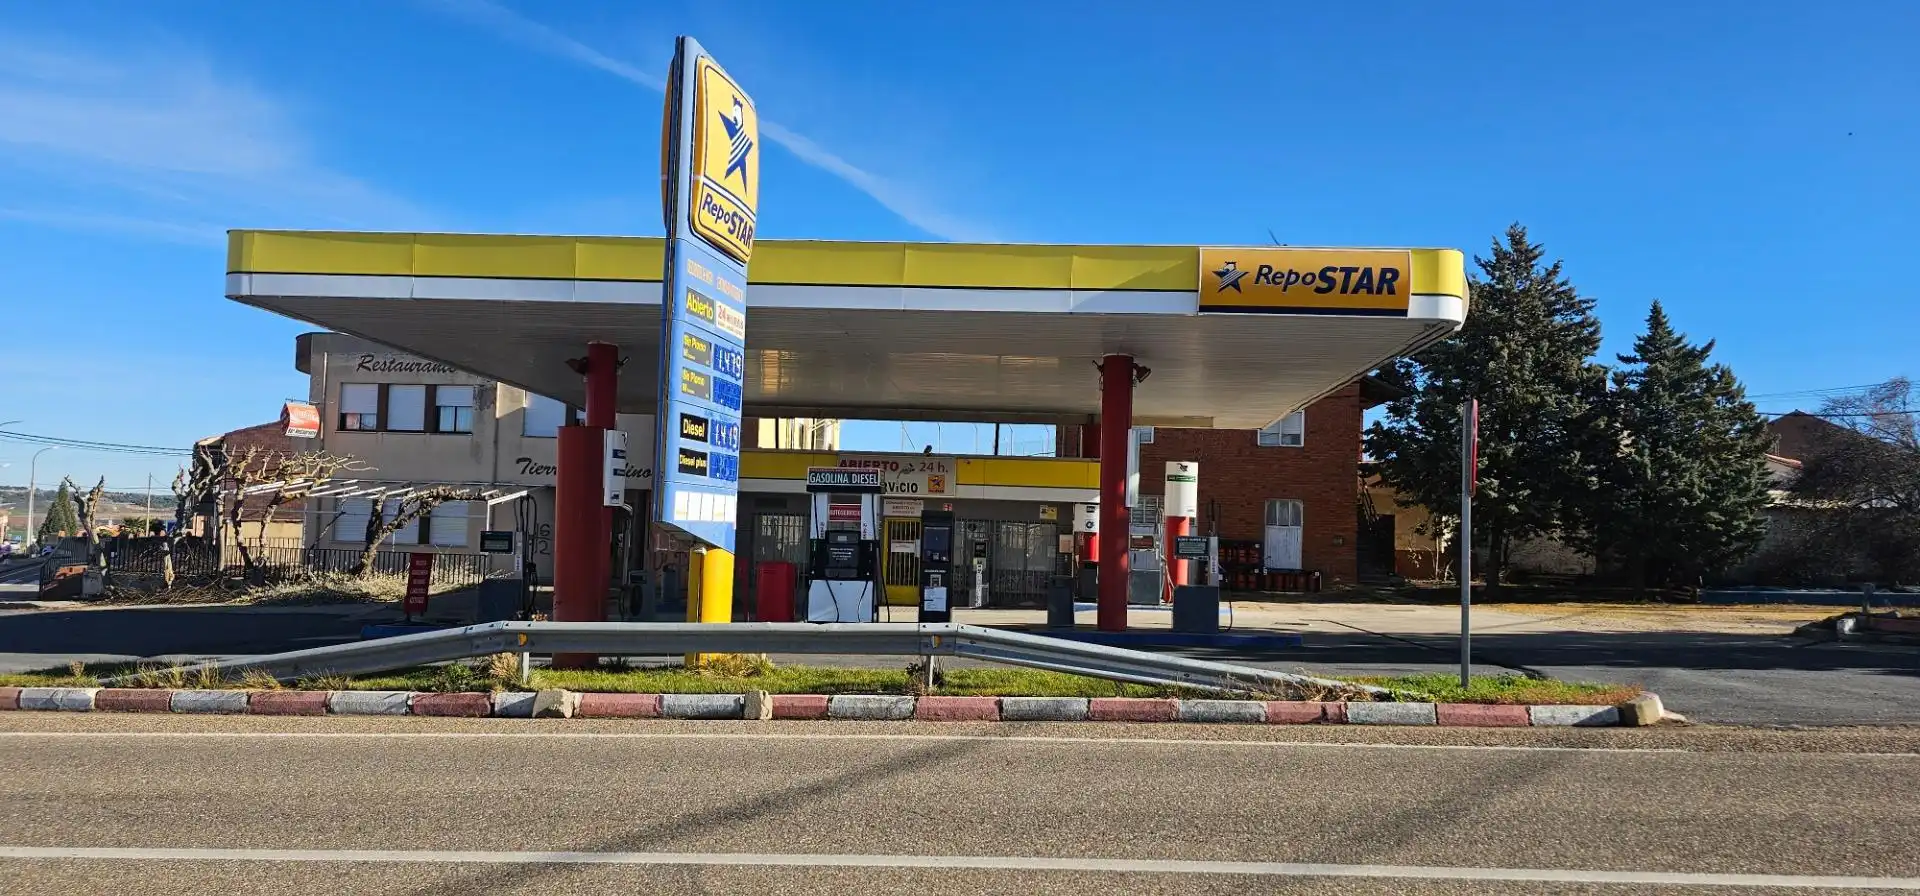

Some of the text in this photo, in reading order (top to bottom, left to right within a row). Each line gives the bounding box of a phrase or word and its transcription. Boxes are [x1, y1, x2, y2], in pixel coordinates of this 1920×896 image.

[702, 192, 754, 250] RepoSTAR
[1254, 264, 1400, 296] RepoSTAR
[687, 291, 714, 320] Abierto
[683, 418, 705, 438] Diesel
[515, 457, 652, 478] Tierr ino
[680, 454, 707, 469] Diesel plus
[919, 462, 934, 473] 24
[809, 472, 878, 484] GASOLINA DIESEL
